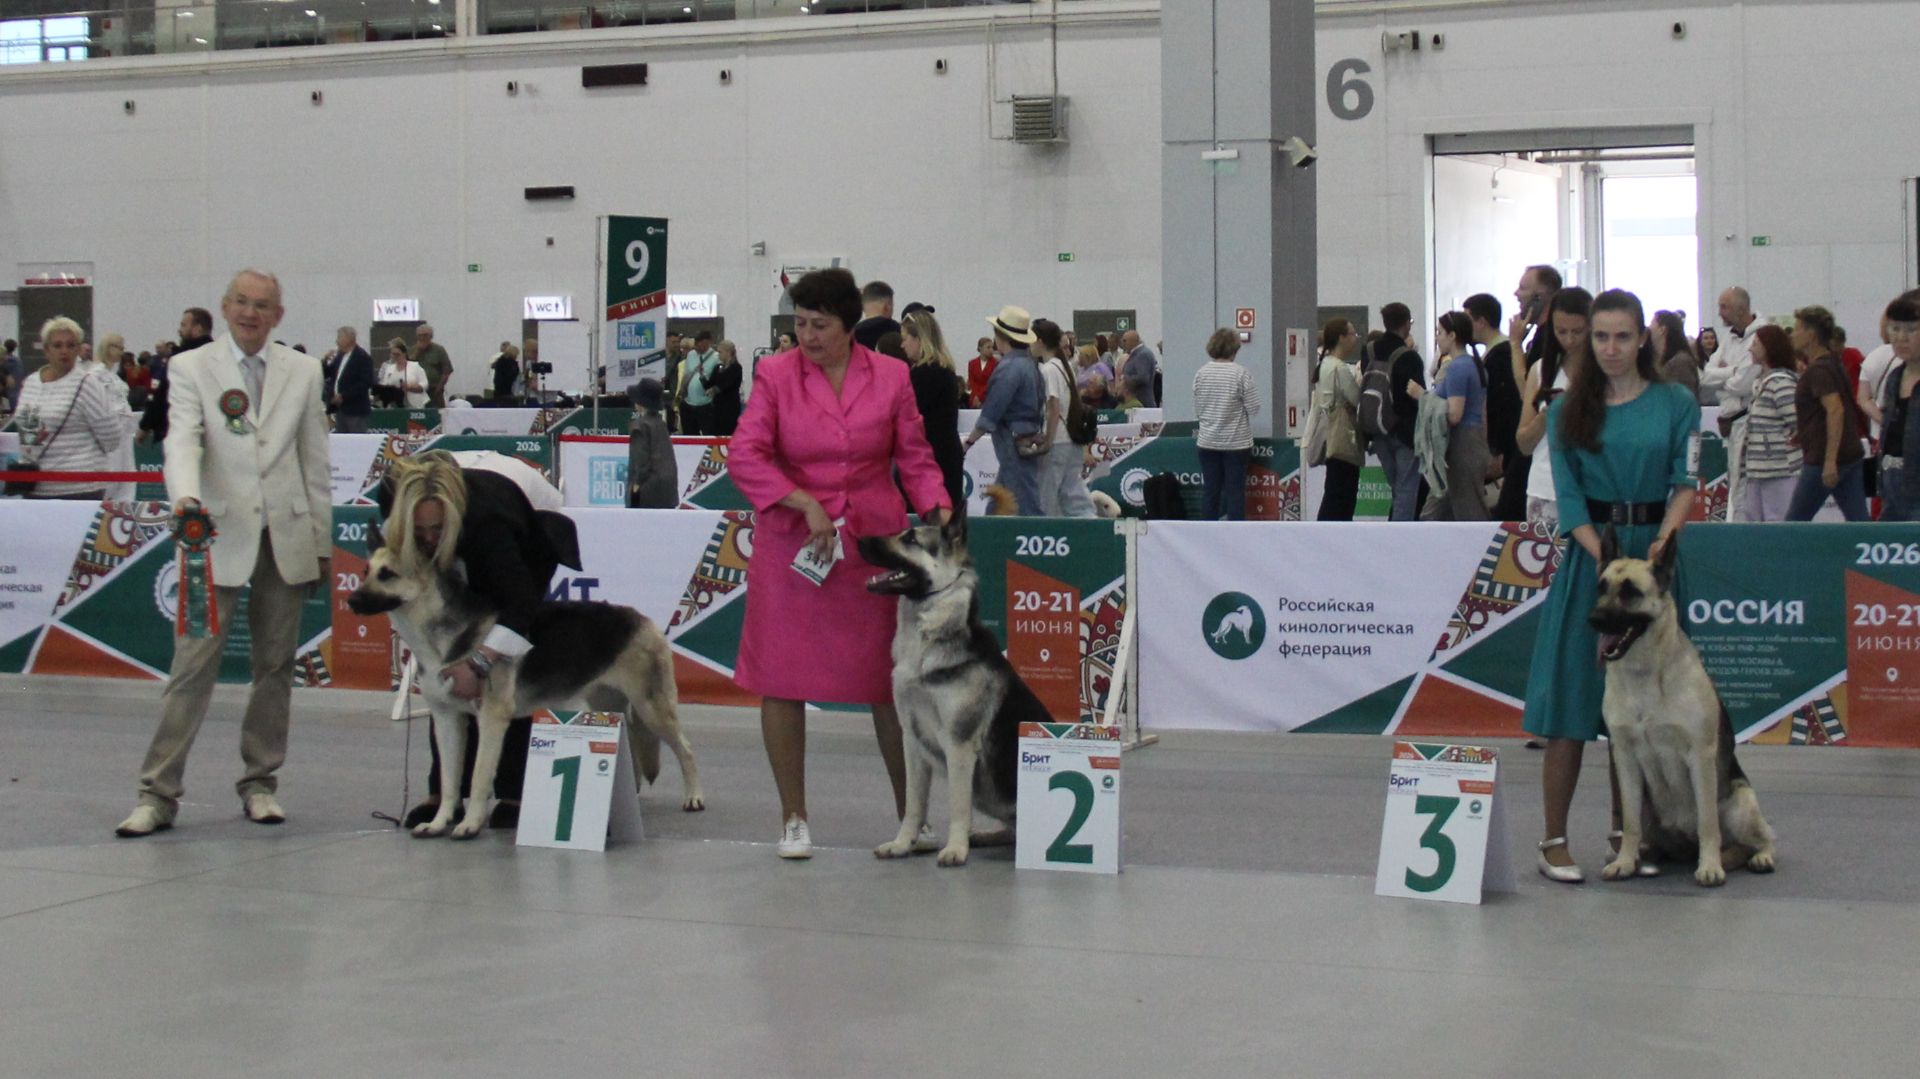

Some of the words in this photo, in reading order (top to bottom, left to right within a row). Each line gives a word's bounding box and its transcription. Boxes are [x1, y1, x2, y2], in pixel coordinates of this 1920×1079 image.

[1326, 58, 1374, 120] 6
[625, 240, 649, 286] 9
[385, 305, 400, 315] WC
[536, 304, 552, 313] WC
[680, 301, 697, 311] WC
[619, 324, 636, 335] PET
[619, 335, 647, 348] PRIDE
[515, 441, 541, 452] 2026
[1251, 446, 1274, 457] 026
[594, 461, 617, 479] PET
[593, 481, 625, 499] PRID
[338, 523, 371, 541] 202
[1015, 535, 1071, 556] 2026
[1855, 543, 1920, 565] 2026
[1013, 591, 1073, 612] 20-21
[1279, 597, 1375, 613] Российская
[1688, 599, 1804, 624] ОССИЯ
[1016, 620, 1073, 634] ИЮНЯ
[1279, 622, 1414, 635] кинологическая
[1279, 640, 1371, 659] федерация
[530, 737, 556, 749] Брит
[1022, 752, 1051, 765] Брит
[1390, 774, 1420, 787] Брит
[551, 755, 582, 842] 1
[1045, 770, 1095, 864] 2
[1404, 794, 1461, 893] 3
